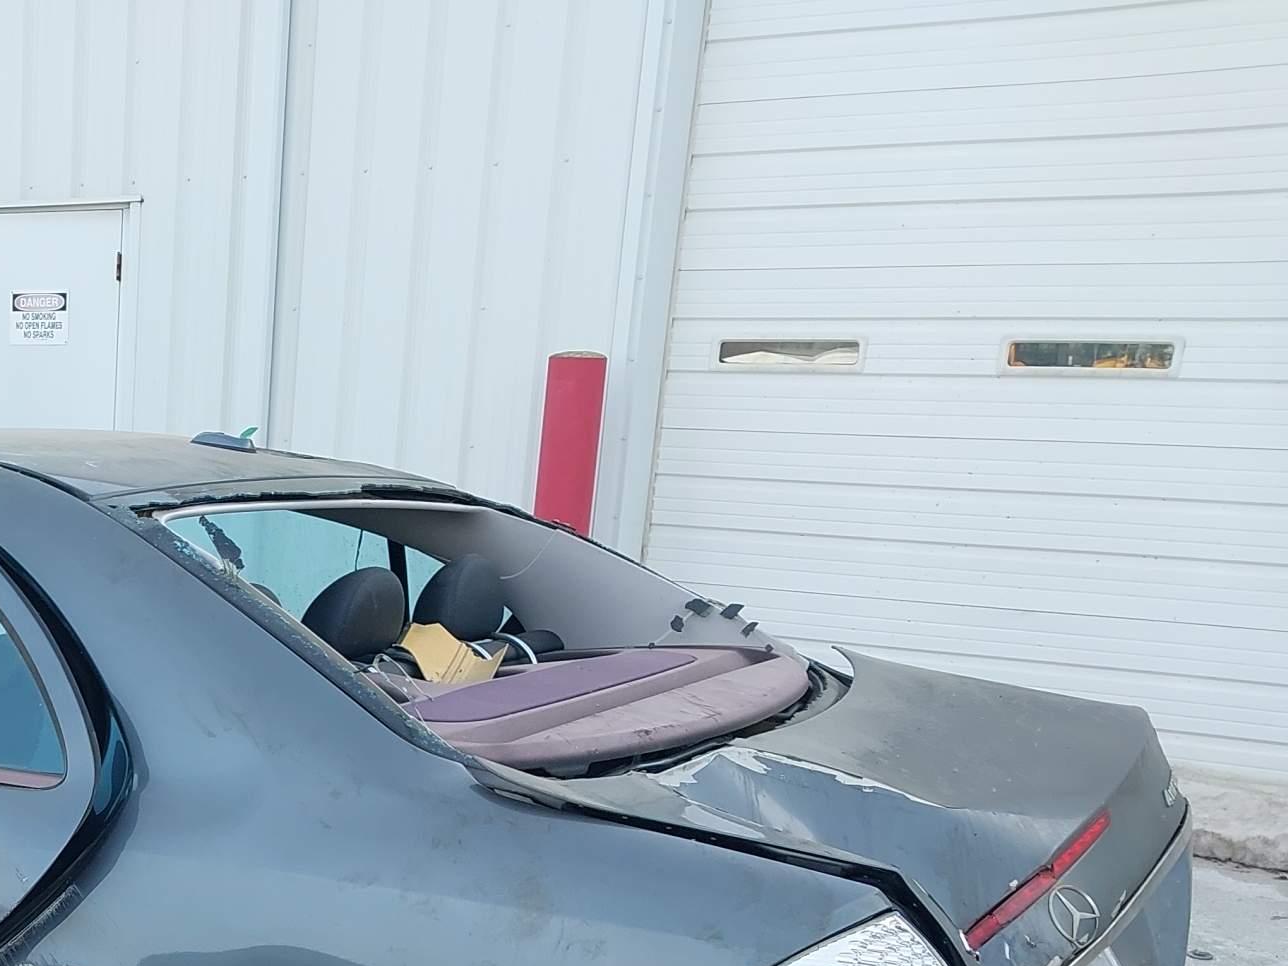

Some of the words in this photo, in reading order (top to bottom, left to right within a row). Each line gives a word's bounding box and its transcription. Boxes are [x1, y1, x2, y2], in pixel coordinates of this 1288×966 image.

[20, 297, 59, 307] DANGER
[22, 313, 30, 321] NO
[32, 312, 56, 321] SMOKING
[16, 322, 24, 330] NO
[25, 322, 40, 330] OPEN
[41, 322, 62, 330] FLAMES
[24, 331, 32, 339] NO
[32, 331, 54, 339] SPARKS
